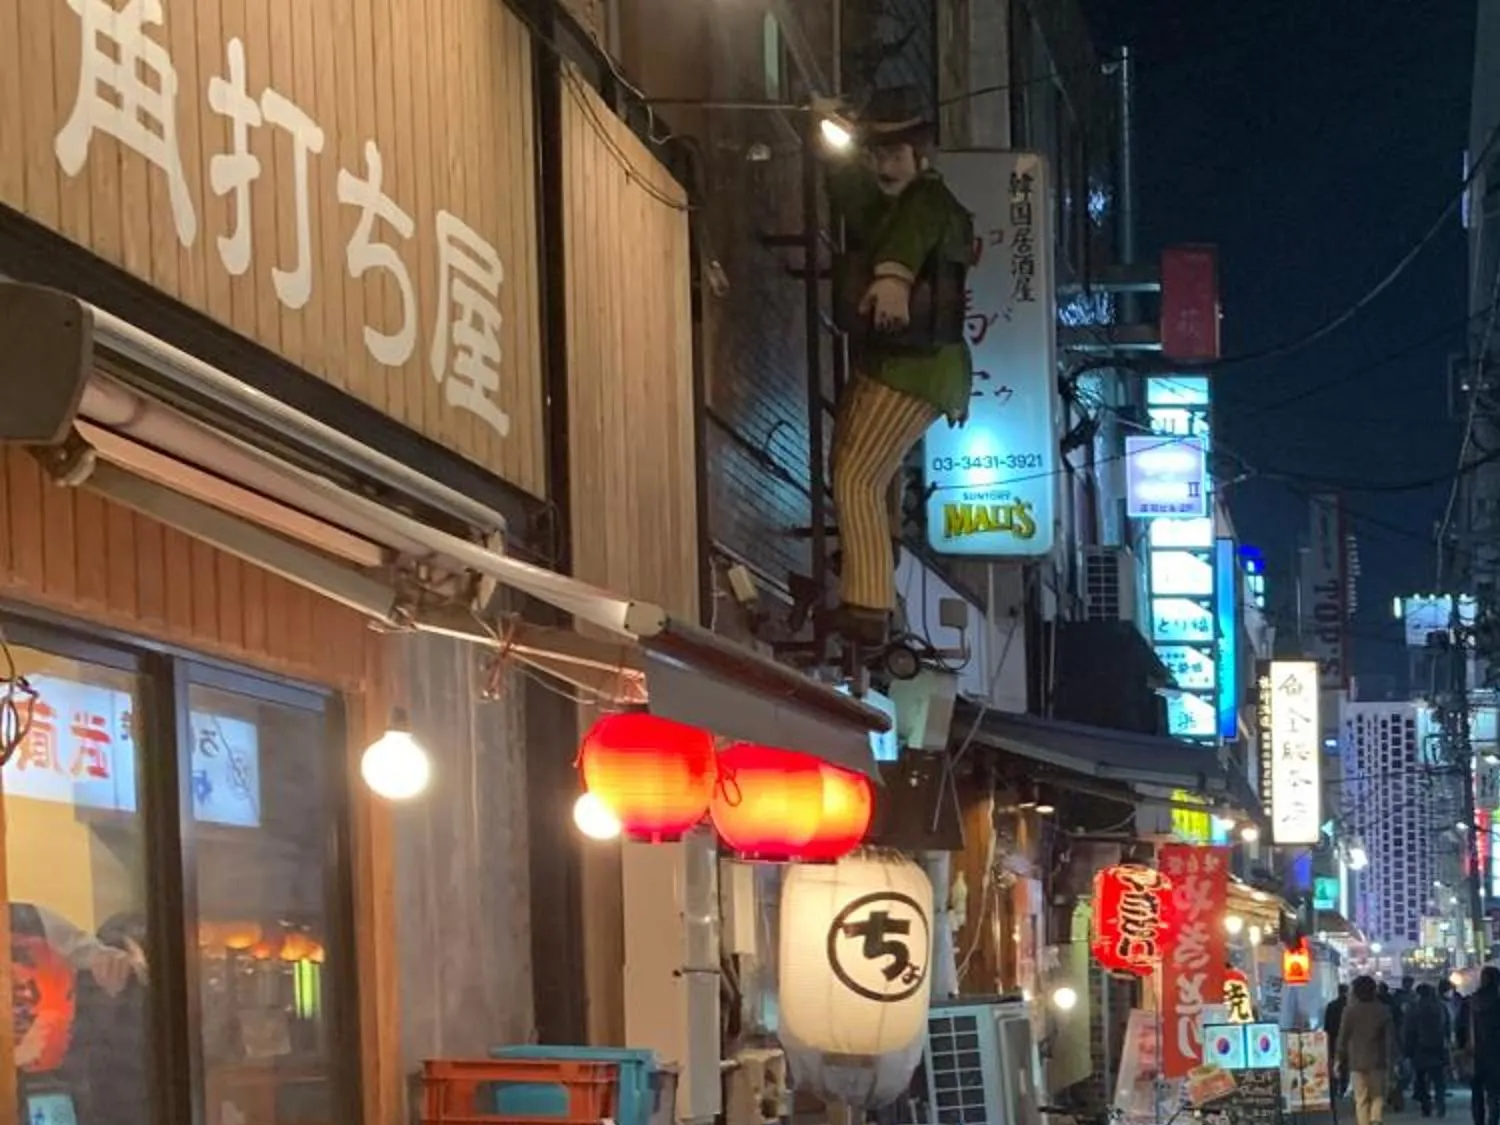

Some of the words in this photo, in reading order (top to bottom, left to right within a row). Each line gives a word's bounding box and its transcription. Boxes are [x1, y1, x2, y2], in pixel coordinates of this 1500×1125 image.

[55, 0, 510, 438] 角打ち屋
[932, 453, 1044, 473] 03-3431-3921
